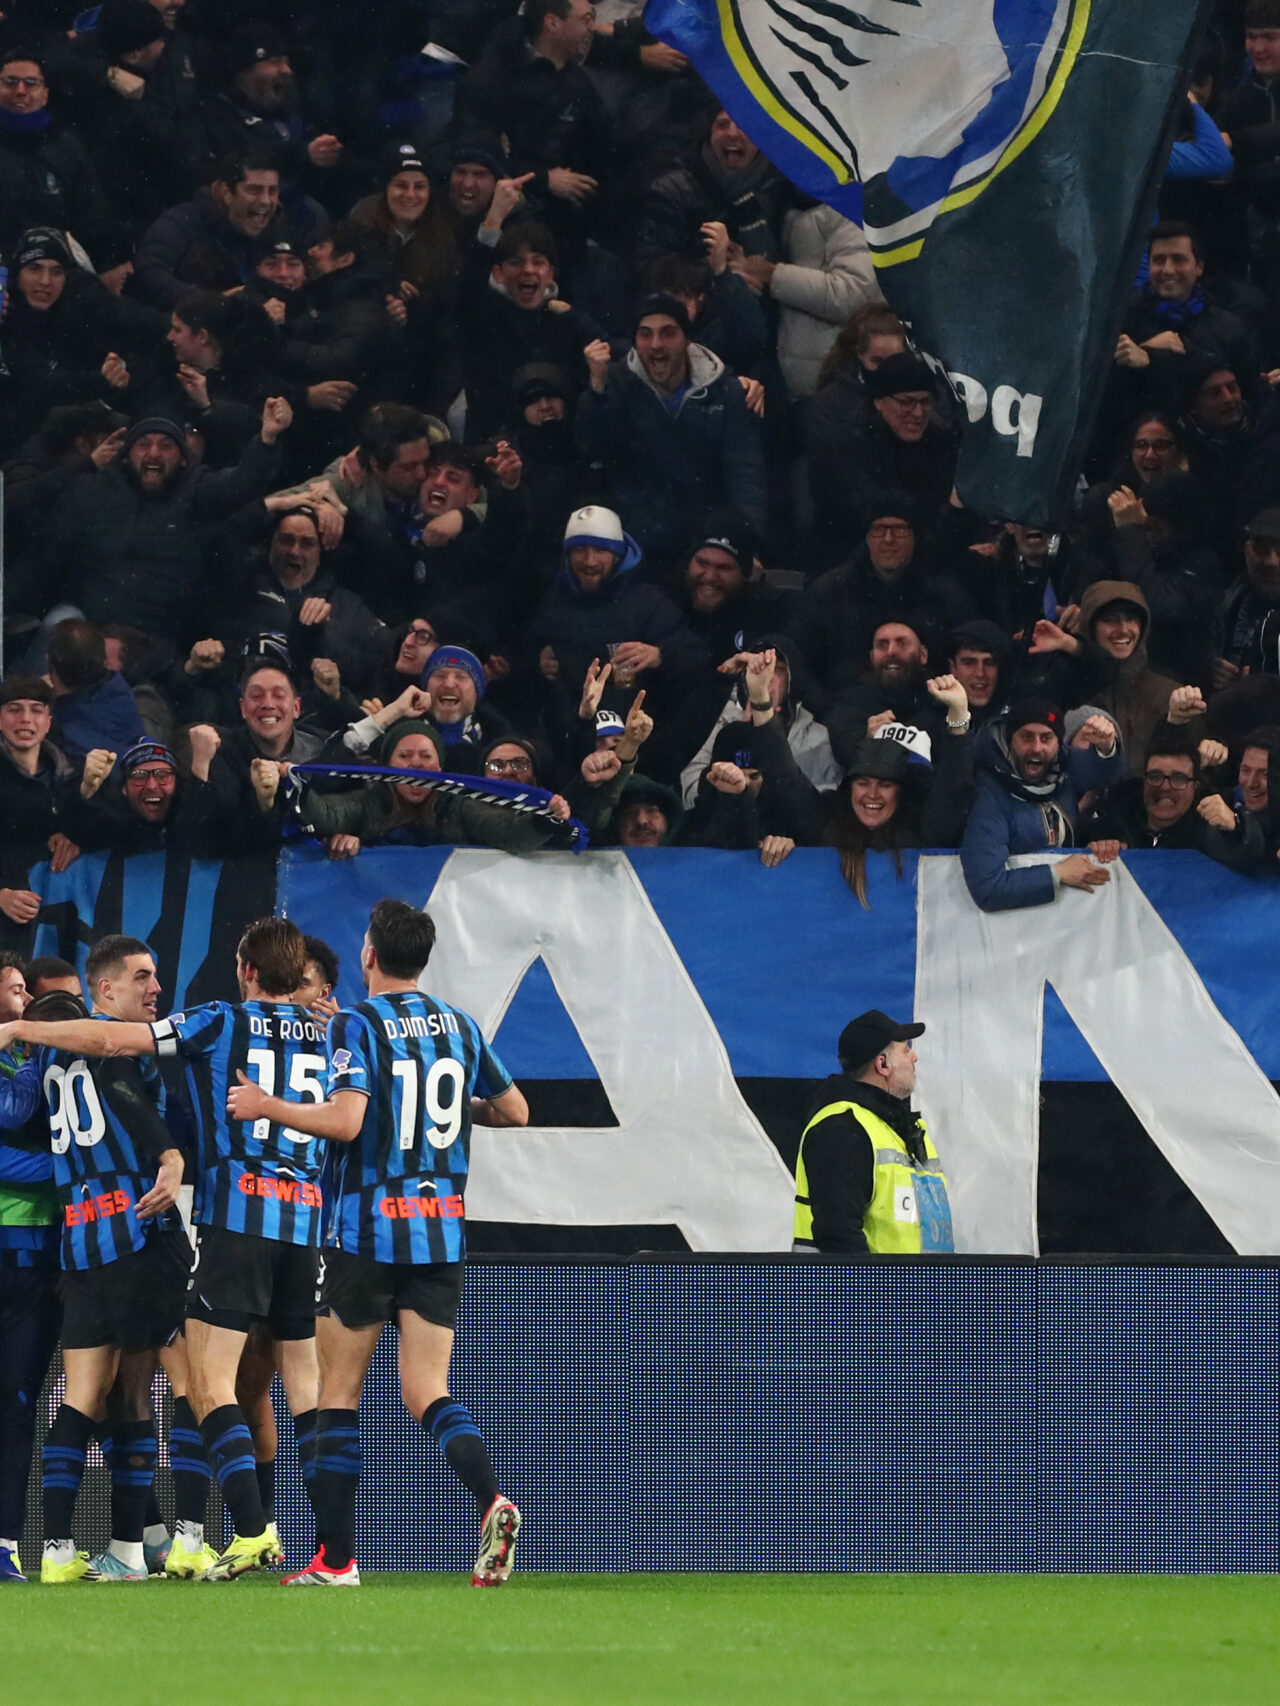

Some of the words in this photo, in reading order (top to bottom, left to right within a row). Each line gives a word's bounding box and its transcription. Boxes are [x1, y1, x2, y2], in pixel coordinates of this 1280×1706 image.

[881, 725, 917, 747] 1907
[249, 1015, 273, 1038] DE
[383, 1013, 460, 1041] DJIMSITI
[43, 1060, 107, 1155] 90
[247, 1048, 327, 1144] 15
[392, 1057, 466, 1150] 19
[379, 1194, 465, 1219] GEWIS
